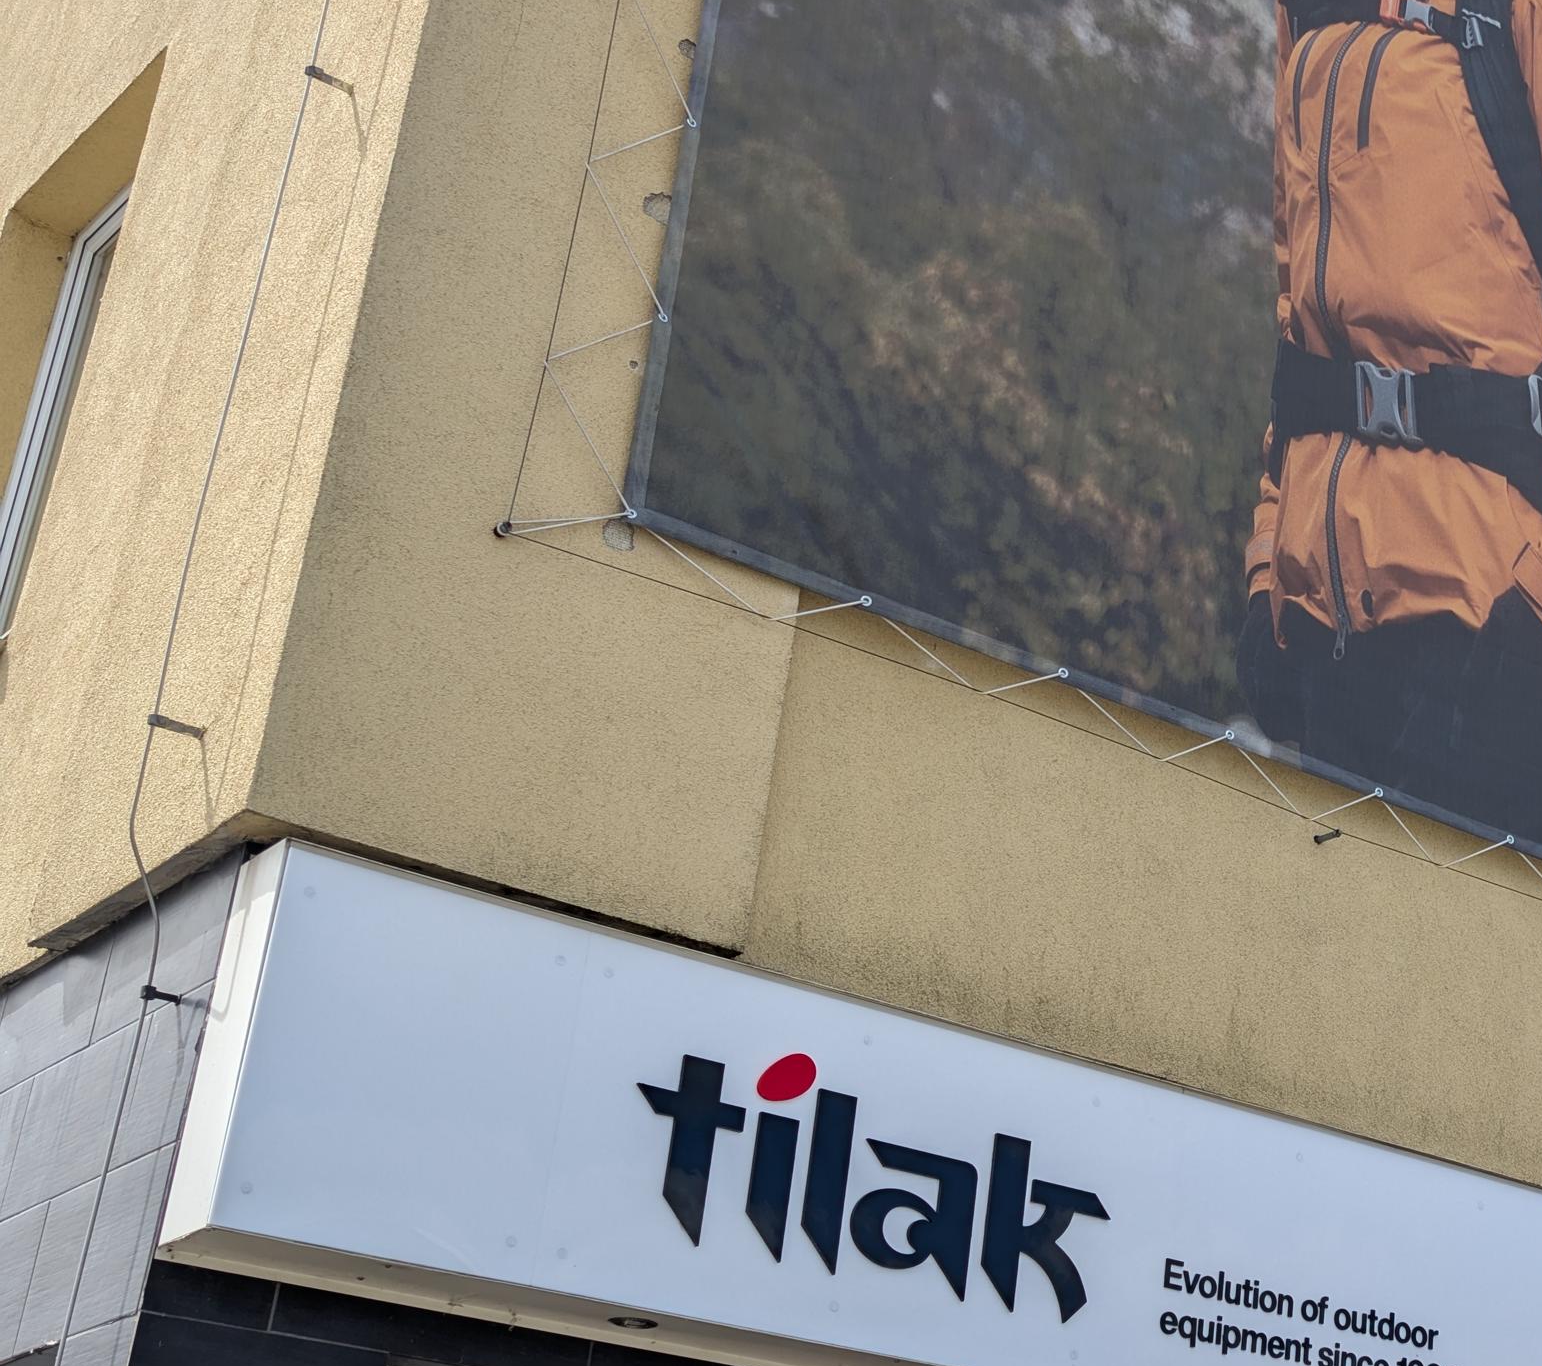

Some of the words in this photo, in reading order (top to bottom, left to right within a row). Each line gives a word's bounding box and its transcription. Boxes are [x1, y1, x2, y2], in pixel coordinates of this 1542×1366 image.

[636, 1053, 1111, 1324] tilak
[1159, 1310, 1313, 1365] equipment
[1163, 1257, 1294, 1318] Evolution
[1300, 1295, 1330, 1325] of
[1333, 1308, 1440, 1351] outdoor
